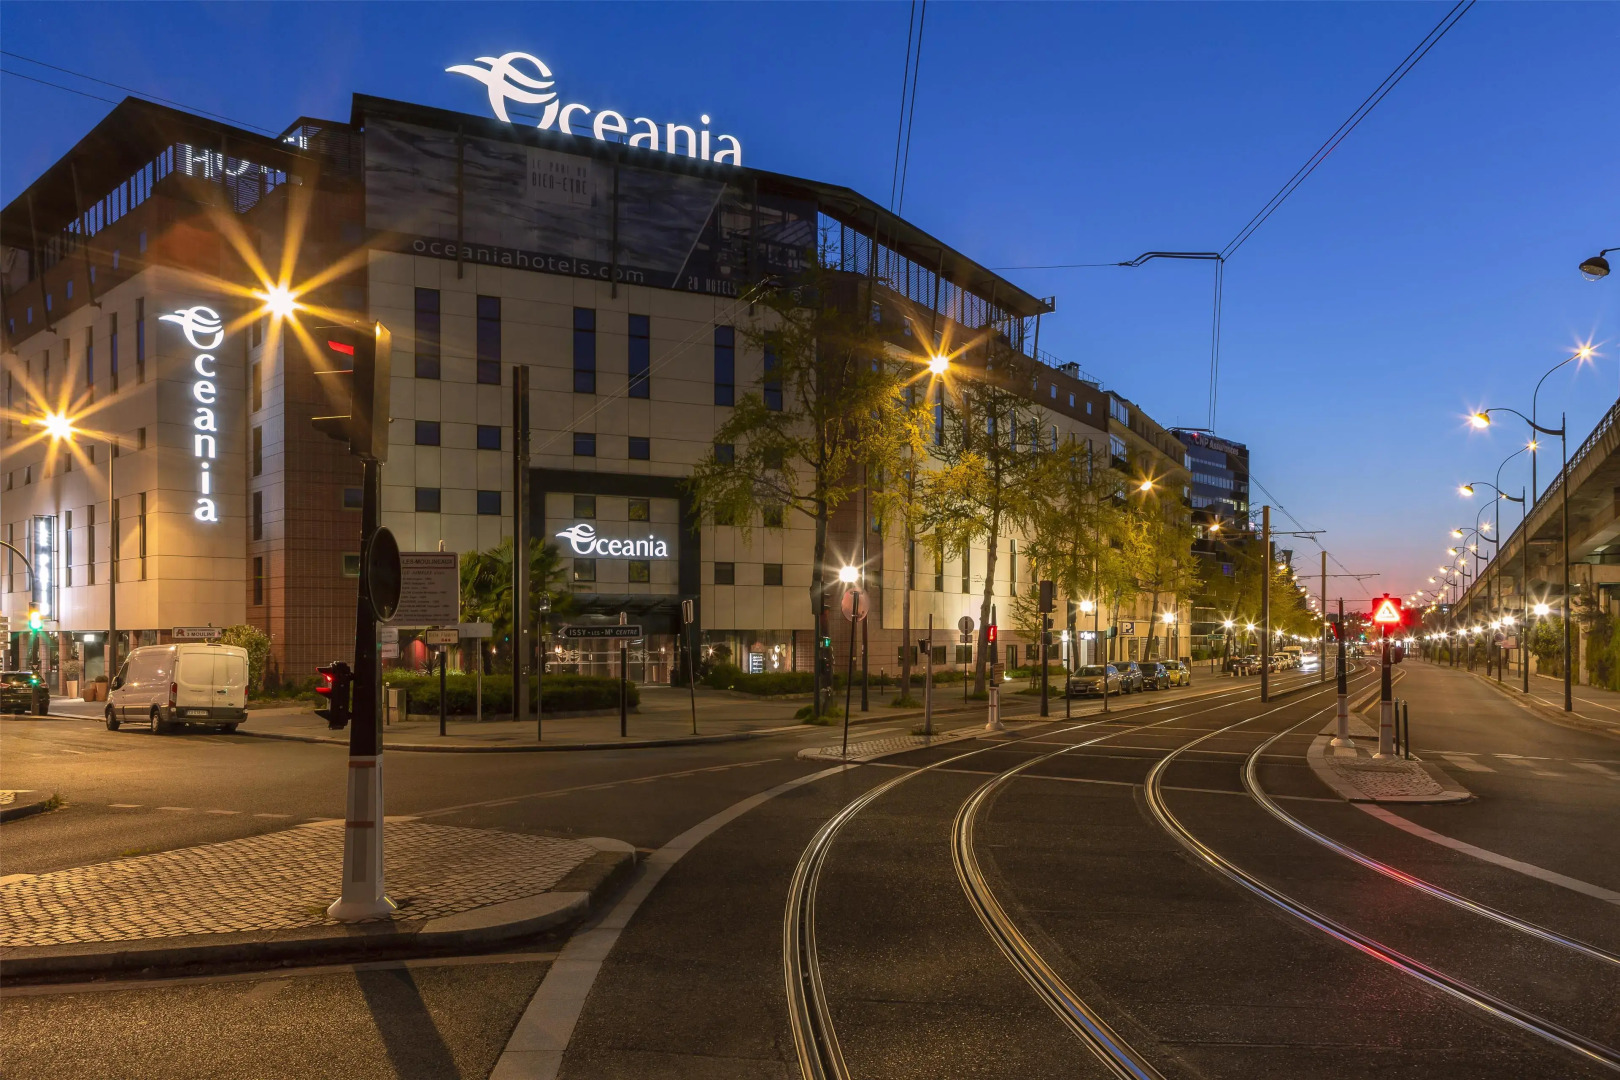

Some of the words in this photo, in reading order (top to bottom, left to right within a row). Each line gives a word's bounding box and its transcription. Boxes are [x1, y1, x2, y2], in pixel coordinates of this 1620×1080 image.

[445, 51, 742, 166] Oceania
[412, 238, 645, 284] oceaniahotels.com
[158, 305, 225, 523] Oceania
[555, 523, 668, 557] Oceania
